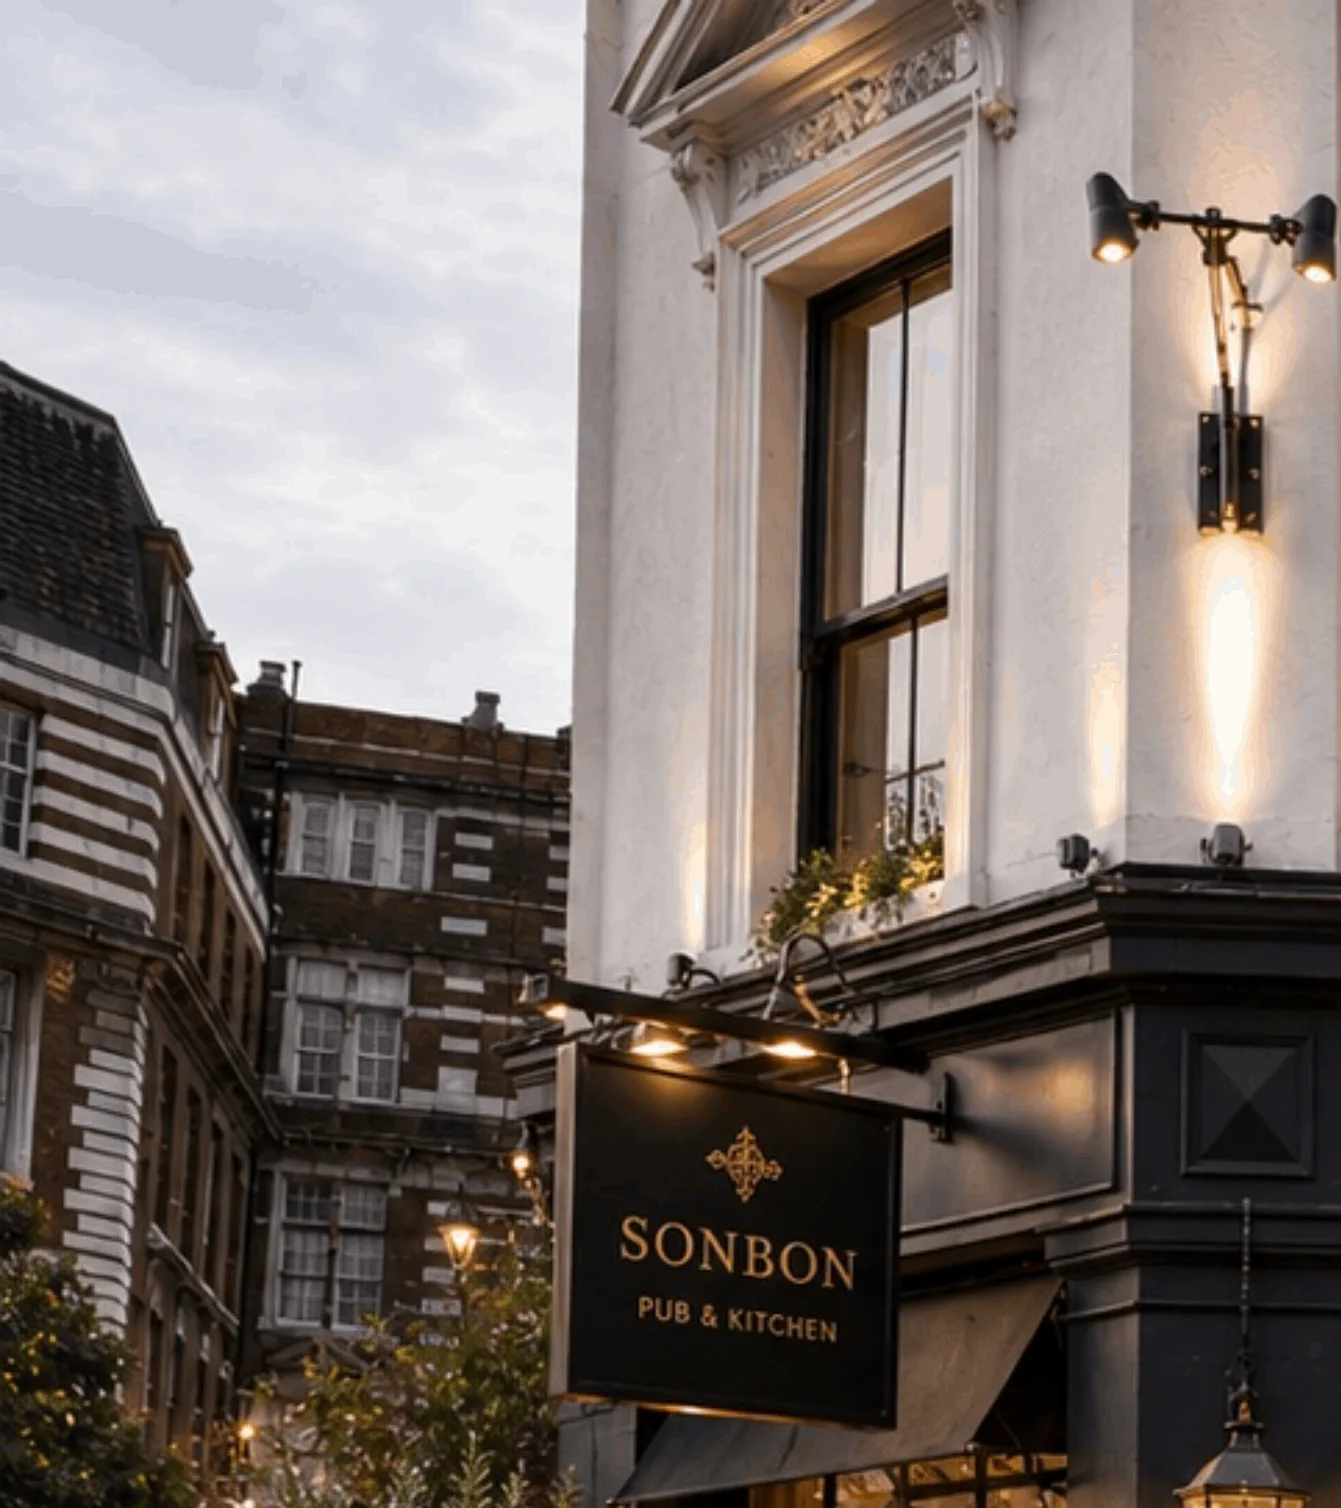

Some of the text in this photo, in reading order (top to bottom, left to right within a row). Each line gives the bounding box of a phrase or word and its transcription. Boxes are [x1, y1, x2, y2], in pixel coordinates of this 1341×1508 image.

[620, 1215, 858, 1290] SONBON
[638, 1296, 838, 1343] PUB & KITCHEN
